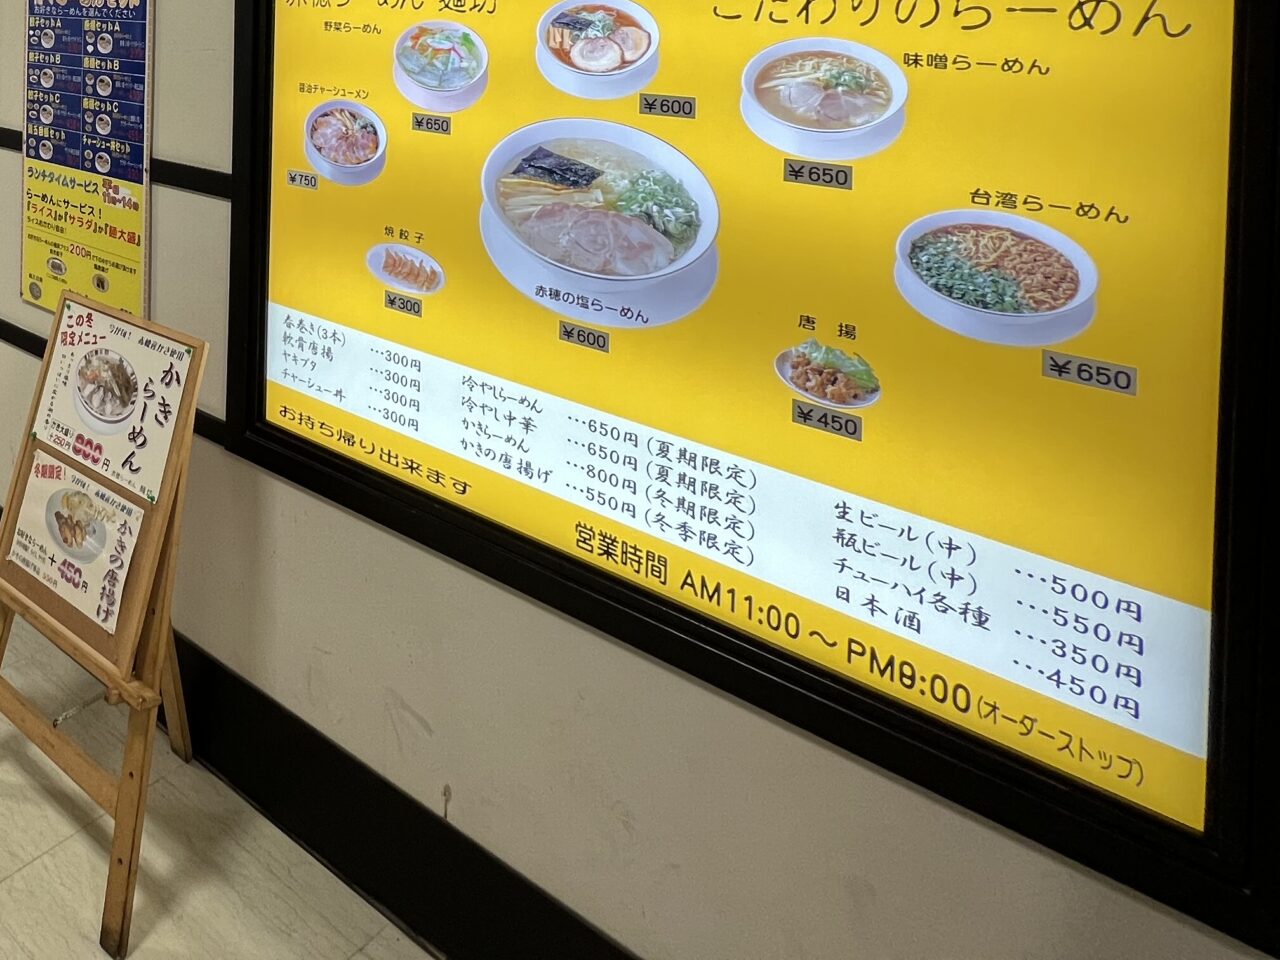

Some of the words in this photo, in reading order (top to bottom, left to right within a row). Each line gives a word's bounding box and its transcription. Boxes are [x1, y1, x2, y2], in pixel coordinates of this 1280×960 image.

[323, 20, 382, 35] 野菜らーめん
[903, 52, 1052, 77] 味噌らーめん
[642, 96, 694, 117] ¥600
[413, 116, 450, 134] ¥650
[27, 166, 100, 196] ランチタイムサービス
[288, 172, 318, 189] ¥750
[787, 162, 850, 187] ¥650
[968, 187, 1131, 225] 台湾らーめん
[66, 312, 94, 329] この冬
[386, 293, 421, 316] ¥300
[534, 285, 650, 324] 赤穂の塩らーめん
[61, 331, 107, 347] 限定メニュー
[562, 323, 608, 350] ¥600
[282, 350, 318, 372] ヤキブタ
[1048, 355, 1132, 391] ¥650
[154, 362, 182, 427] かき
[281, 367, 347, 403] チャーシュー丼
[460, 374, 544, 415] 冷やしらーめん
[122, 377, 156, 474] らーめん
[460, 396, 538, 434] 冷やし中華
[796, 405, 858, 436] ¥450
[278, 404, 473, 496] お持ち帰り出来ます
[460, 417, 531, 455] かきらーめん
[459, 436, 554, 485] かきの唐揚げ
[95, 518, 134, 624] かきの唐揚げ
[574, 520, 669, 587] 営業時間
[832, 557, 993, 633] チューハイ各種
[835, 584, 923, 636] 日本酒
